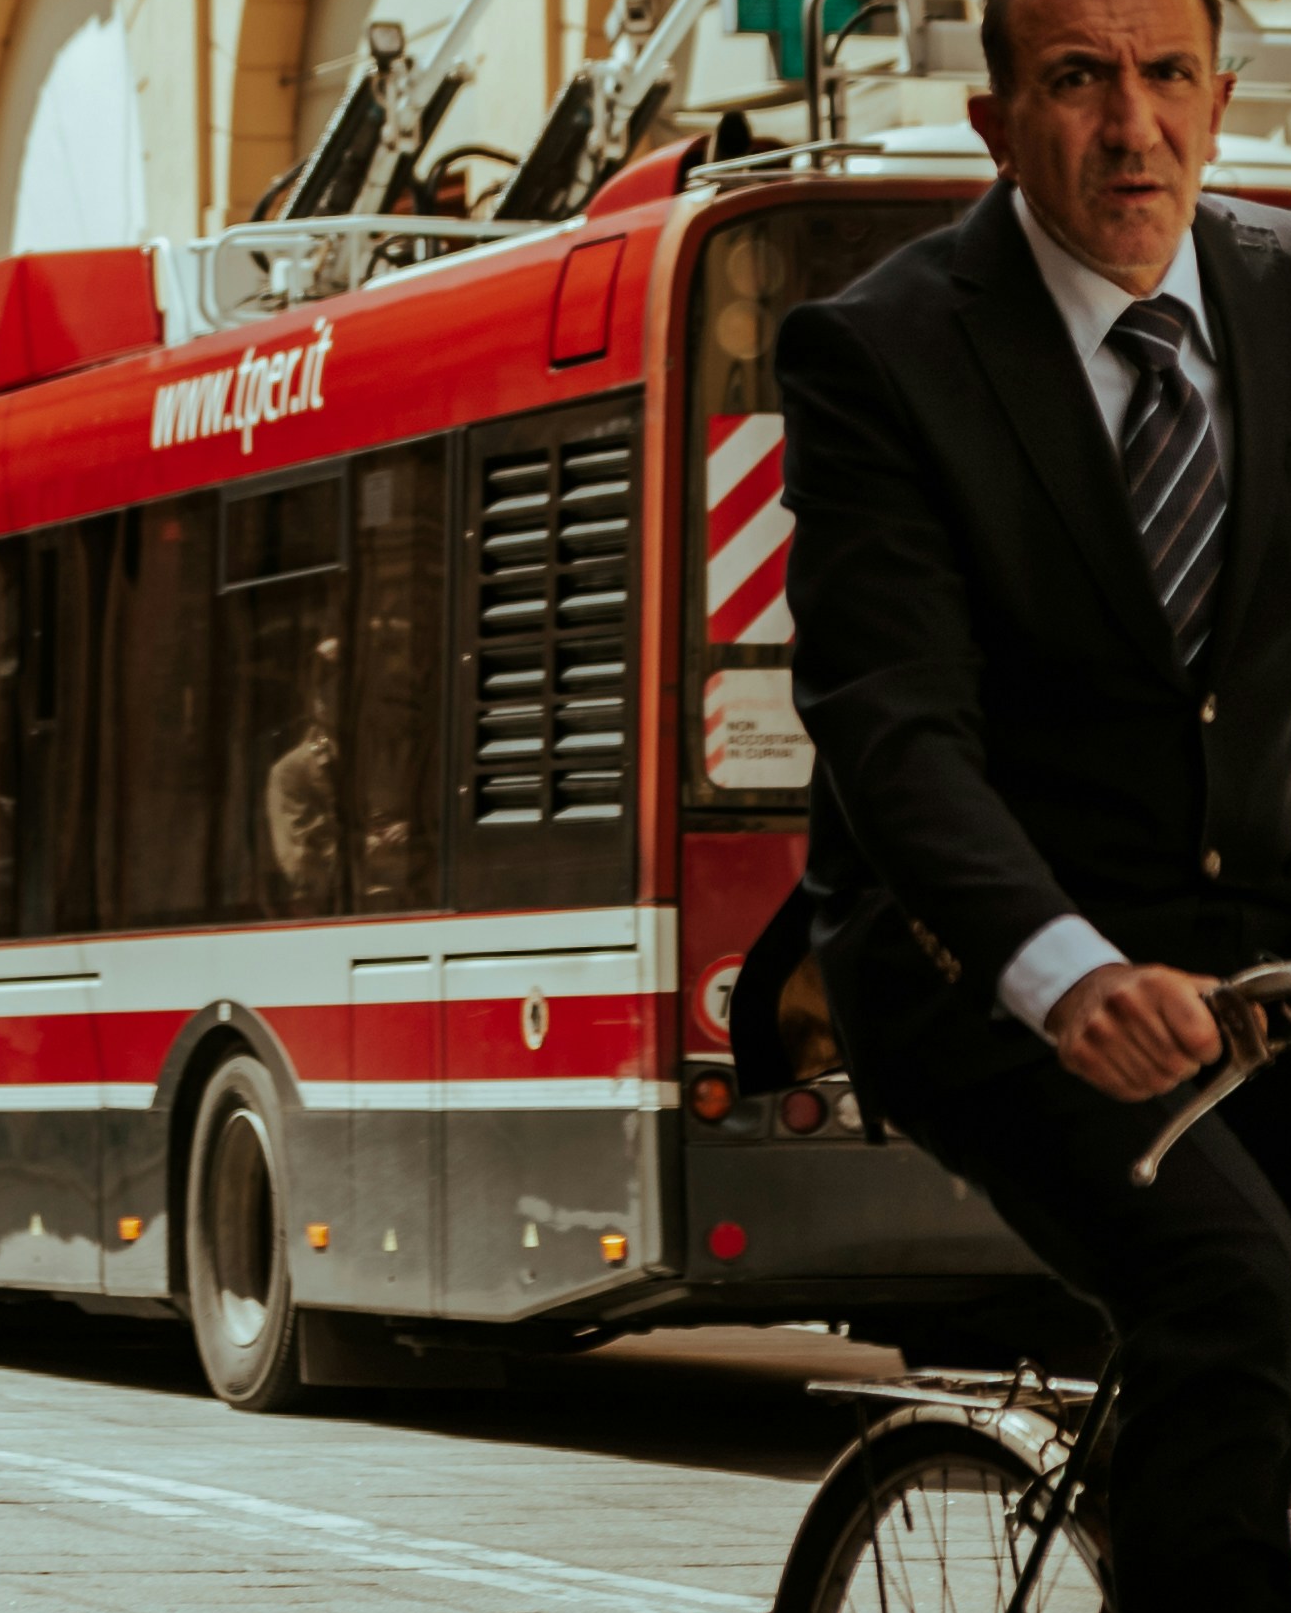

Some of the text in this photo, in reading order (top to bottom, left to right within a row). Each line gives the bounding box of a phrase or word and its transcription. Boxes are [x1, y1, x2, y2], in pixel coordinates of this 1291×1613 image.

[151, 317, 333, 455] www.tper.it
[727, 721, 755, 732] NON
[728, 733, 812, 746] ACCOSTAR
